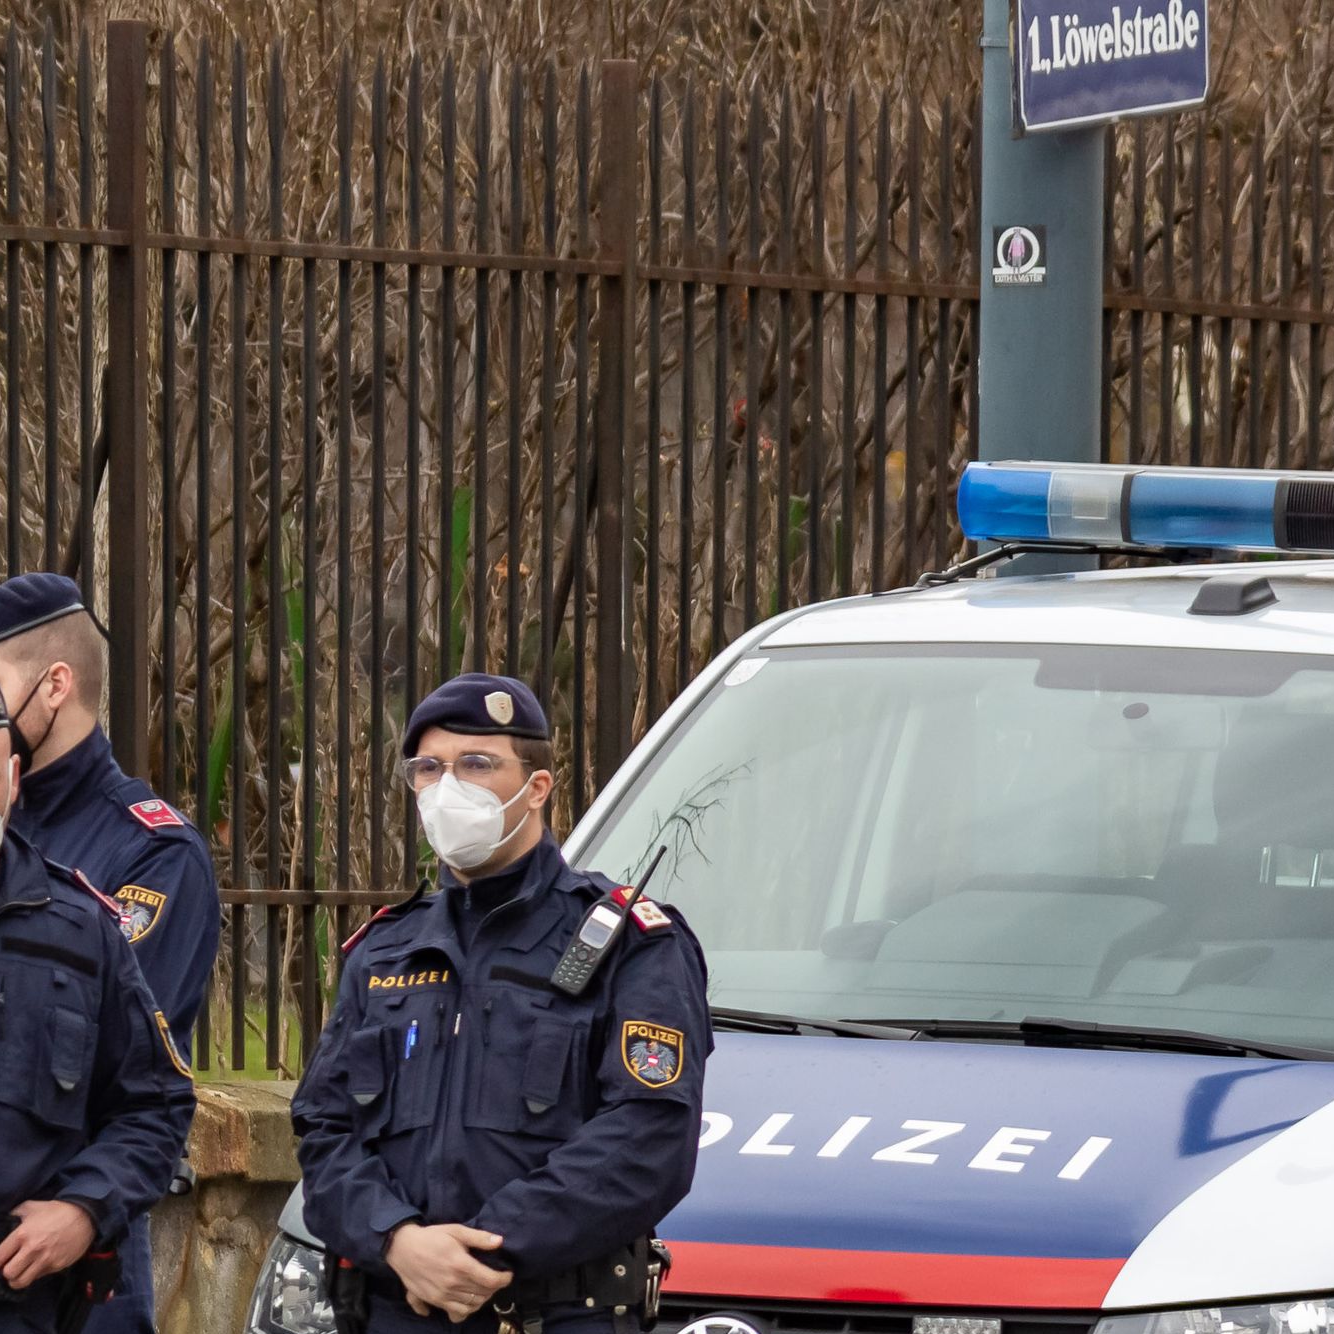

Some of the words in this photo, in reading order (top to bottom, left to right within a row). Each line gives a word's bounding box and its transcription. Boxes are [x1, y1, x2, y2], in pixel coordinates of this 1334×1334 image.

[1050, 0, 1200, 69] Löwelstraße
[117, 889, 160, 906] OLIZEI
[368, 970, 449, 989] POLIZEI
[627, 1025, 677, 1046] POLIZEI
